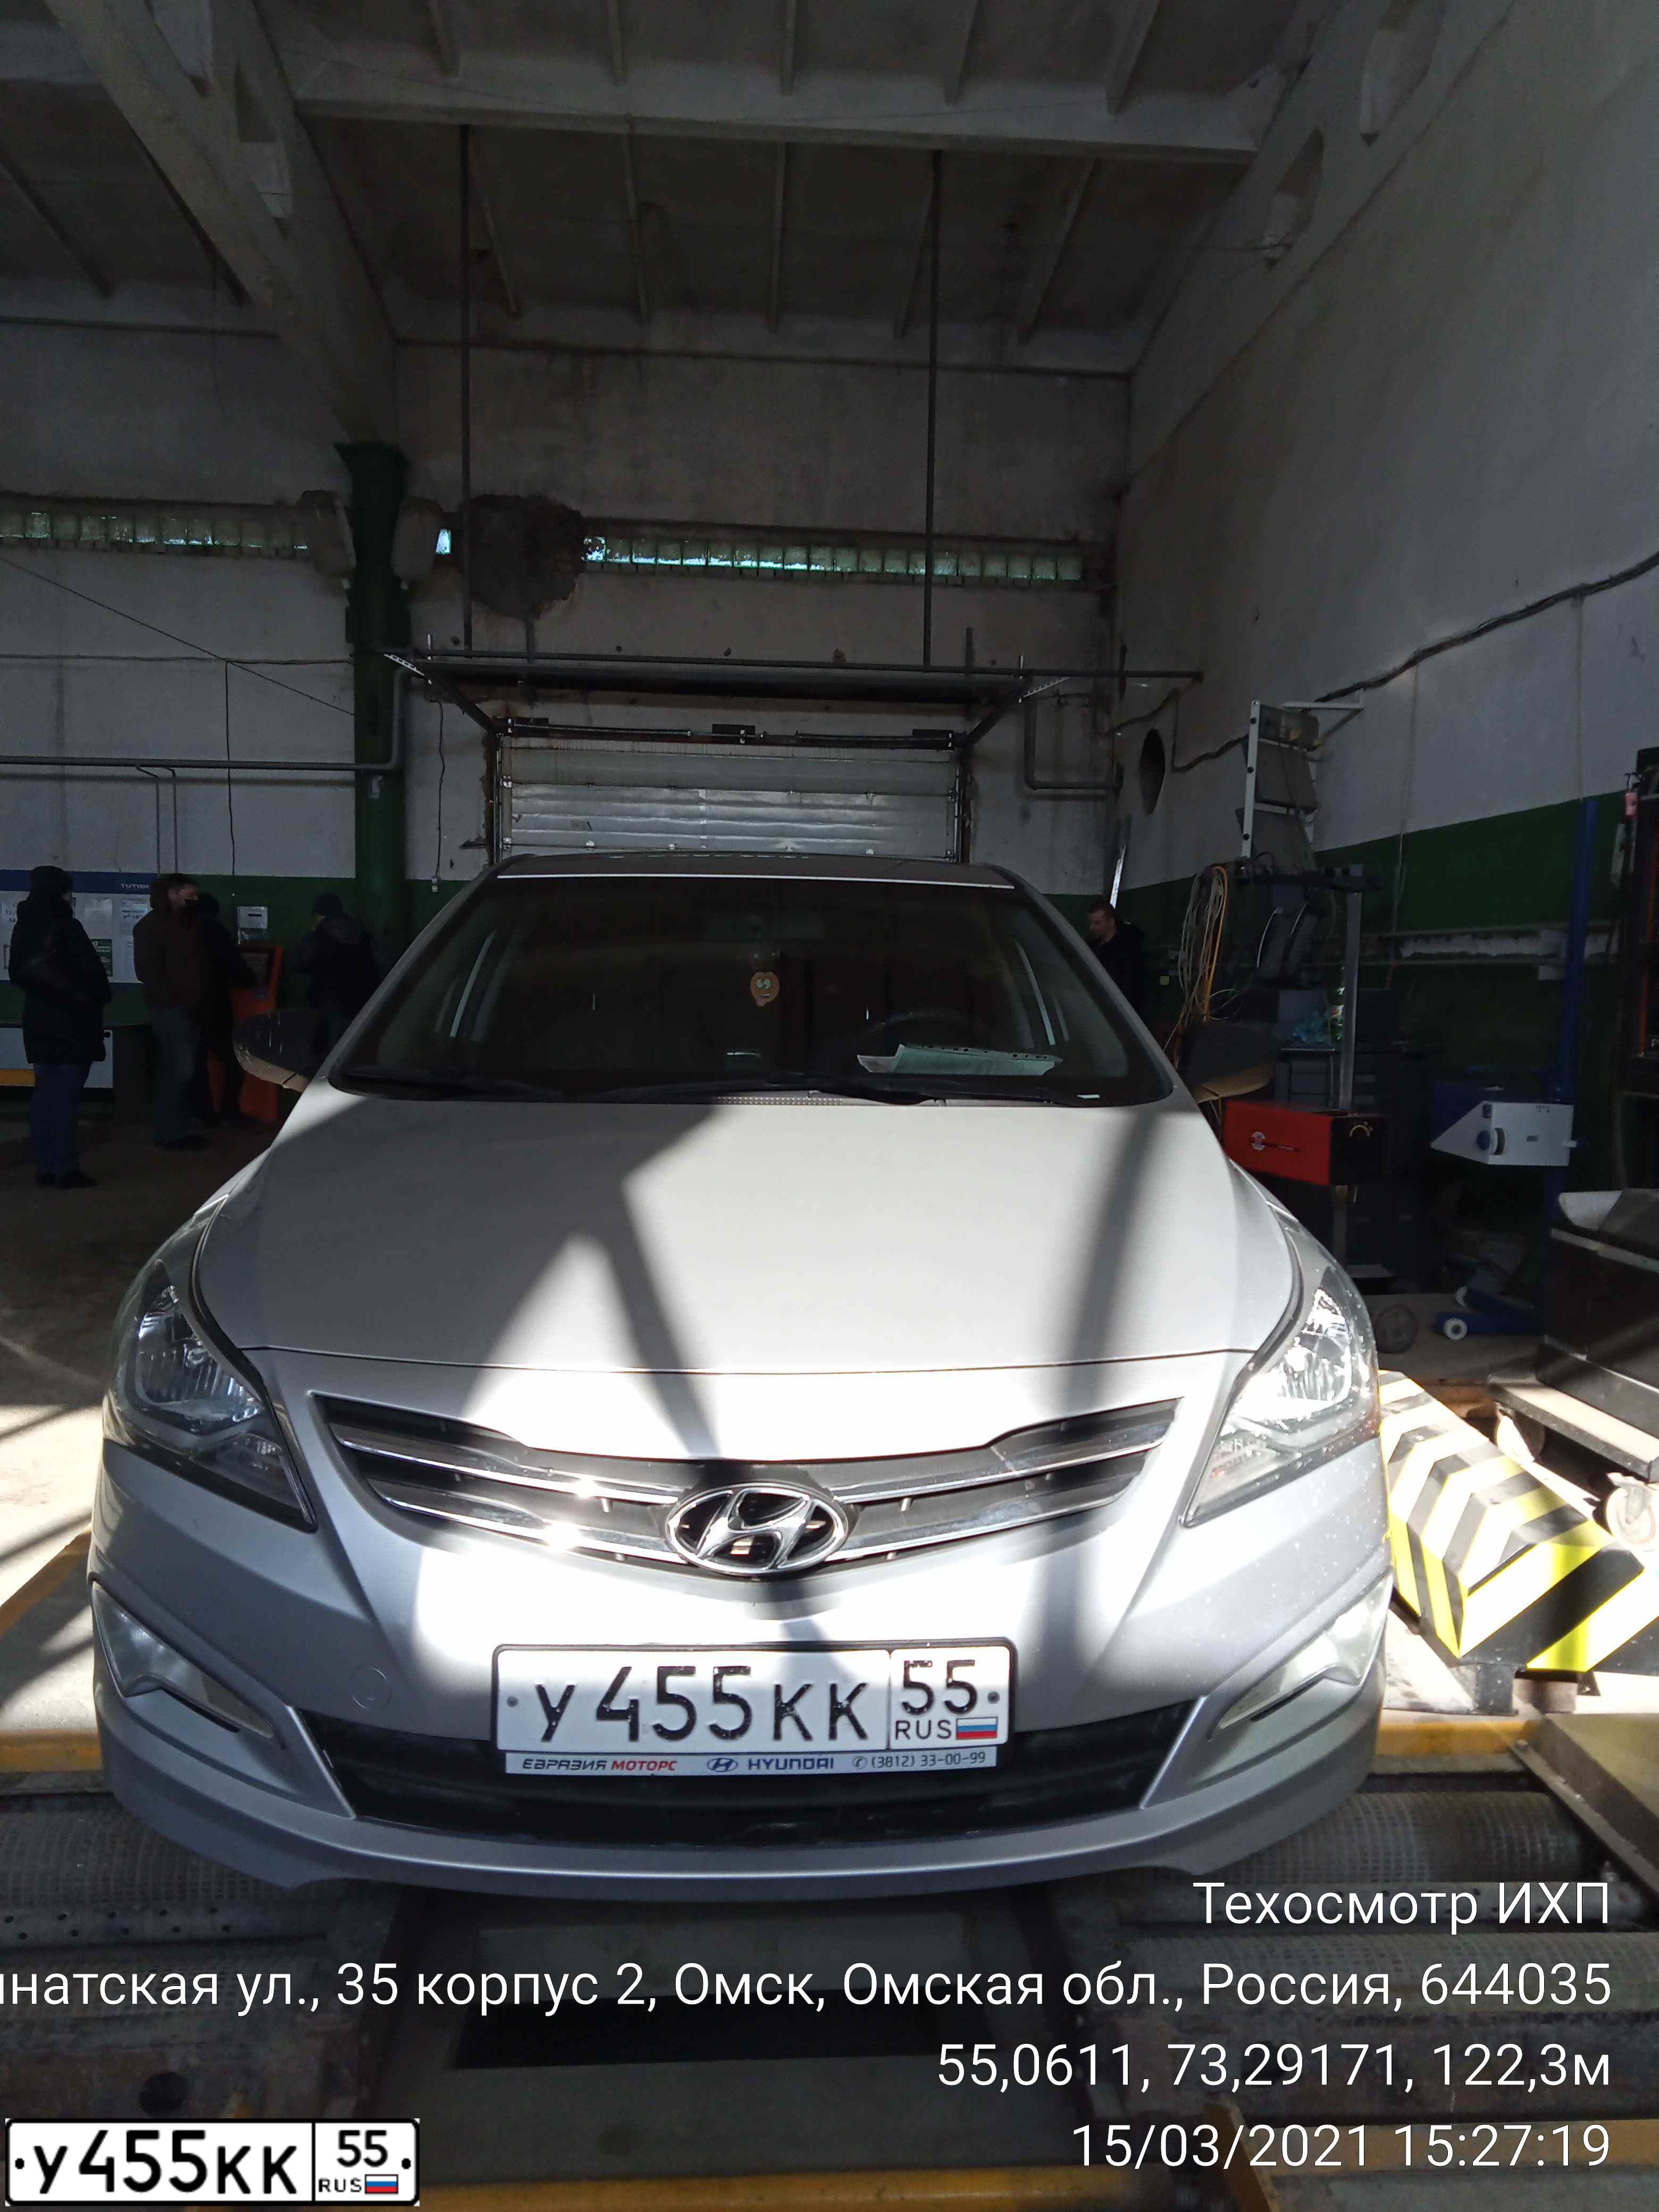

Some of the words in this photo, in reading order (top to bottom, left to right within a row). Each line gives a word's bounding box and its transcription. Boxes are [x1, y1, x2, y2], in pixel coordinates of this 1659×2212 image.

[535, 1665, 868, 1742] У455КК
[901, 1659, 978, 1715] 55
[894, 1719, 952, 1740] RUS
[522, 1758, 607, 1771] ЕВРАЗИЯ
[610, 1759, 677, 1771] МОТОРС
[748, 1757, 834, 1771] HYUNDAI
[871, 1754, 916, 1769] (3812)
[920, 1752, 986, 1767] 33-00-99
